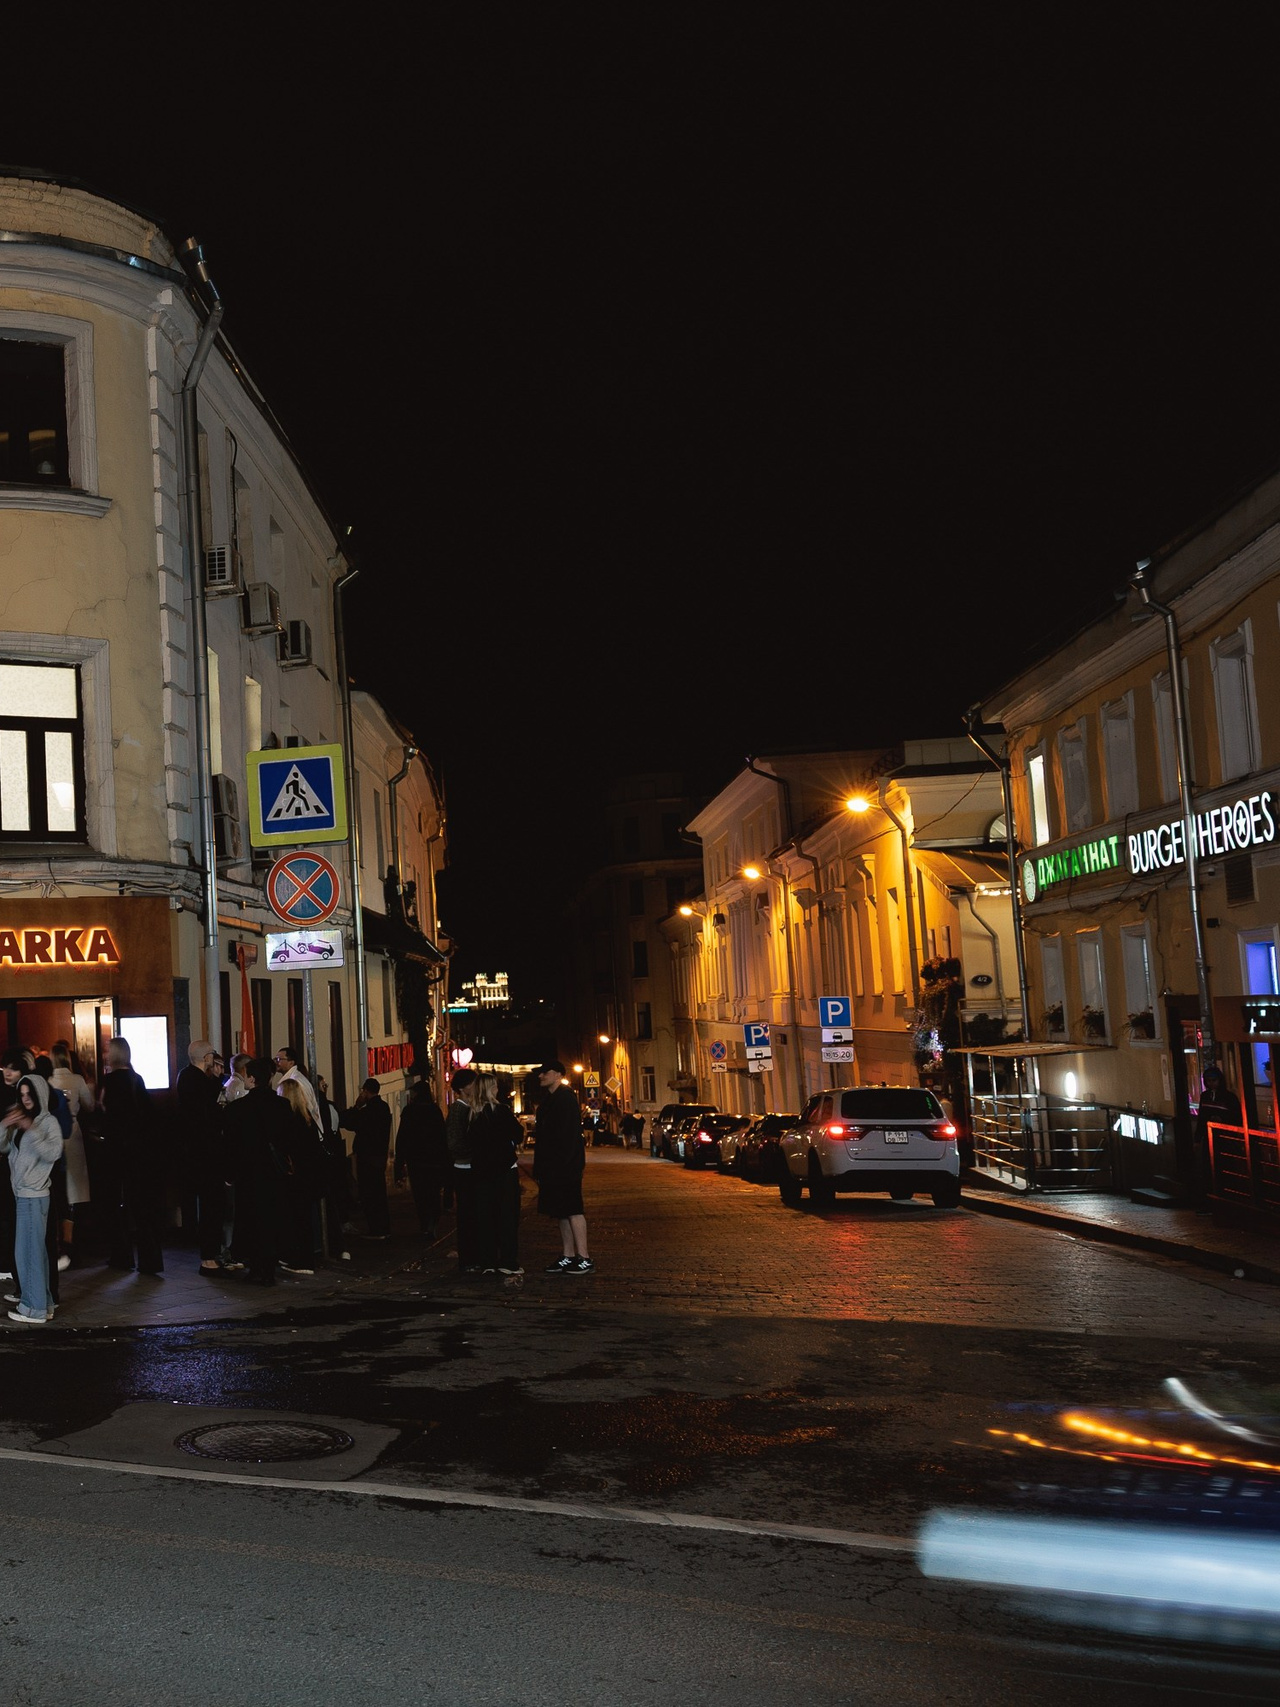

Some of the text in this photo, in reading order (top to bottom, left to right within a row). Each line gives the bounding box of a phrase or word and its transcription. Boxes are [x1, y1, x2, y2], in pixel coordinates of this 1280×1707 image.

[1128, 791, 1275, 874] BURGE HEROES
[826, 1000, 844, 1024] P
